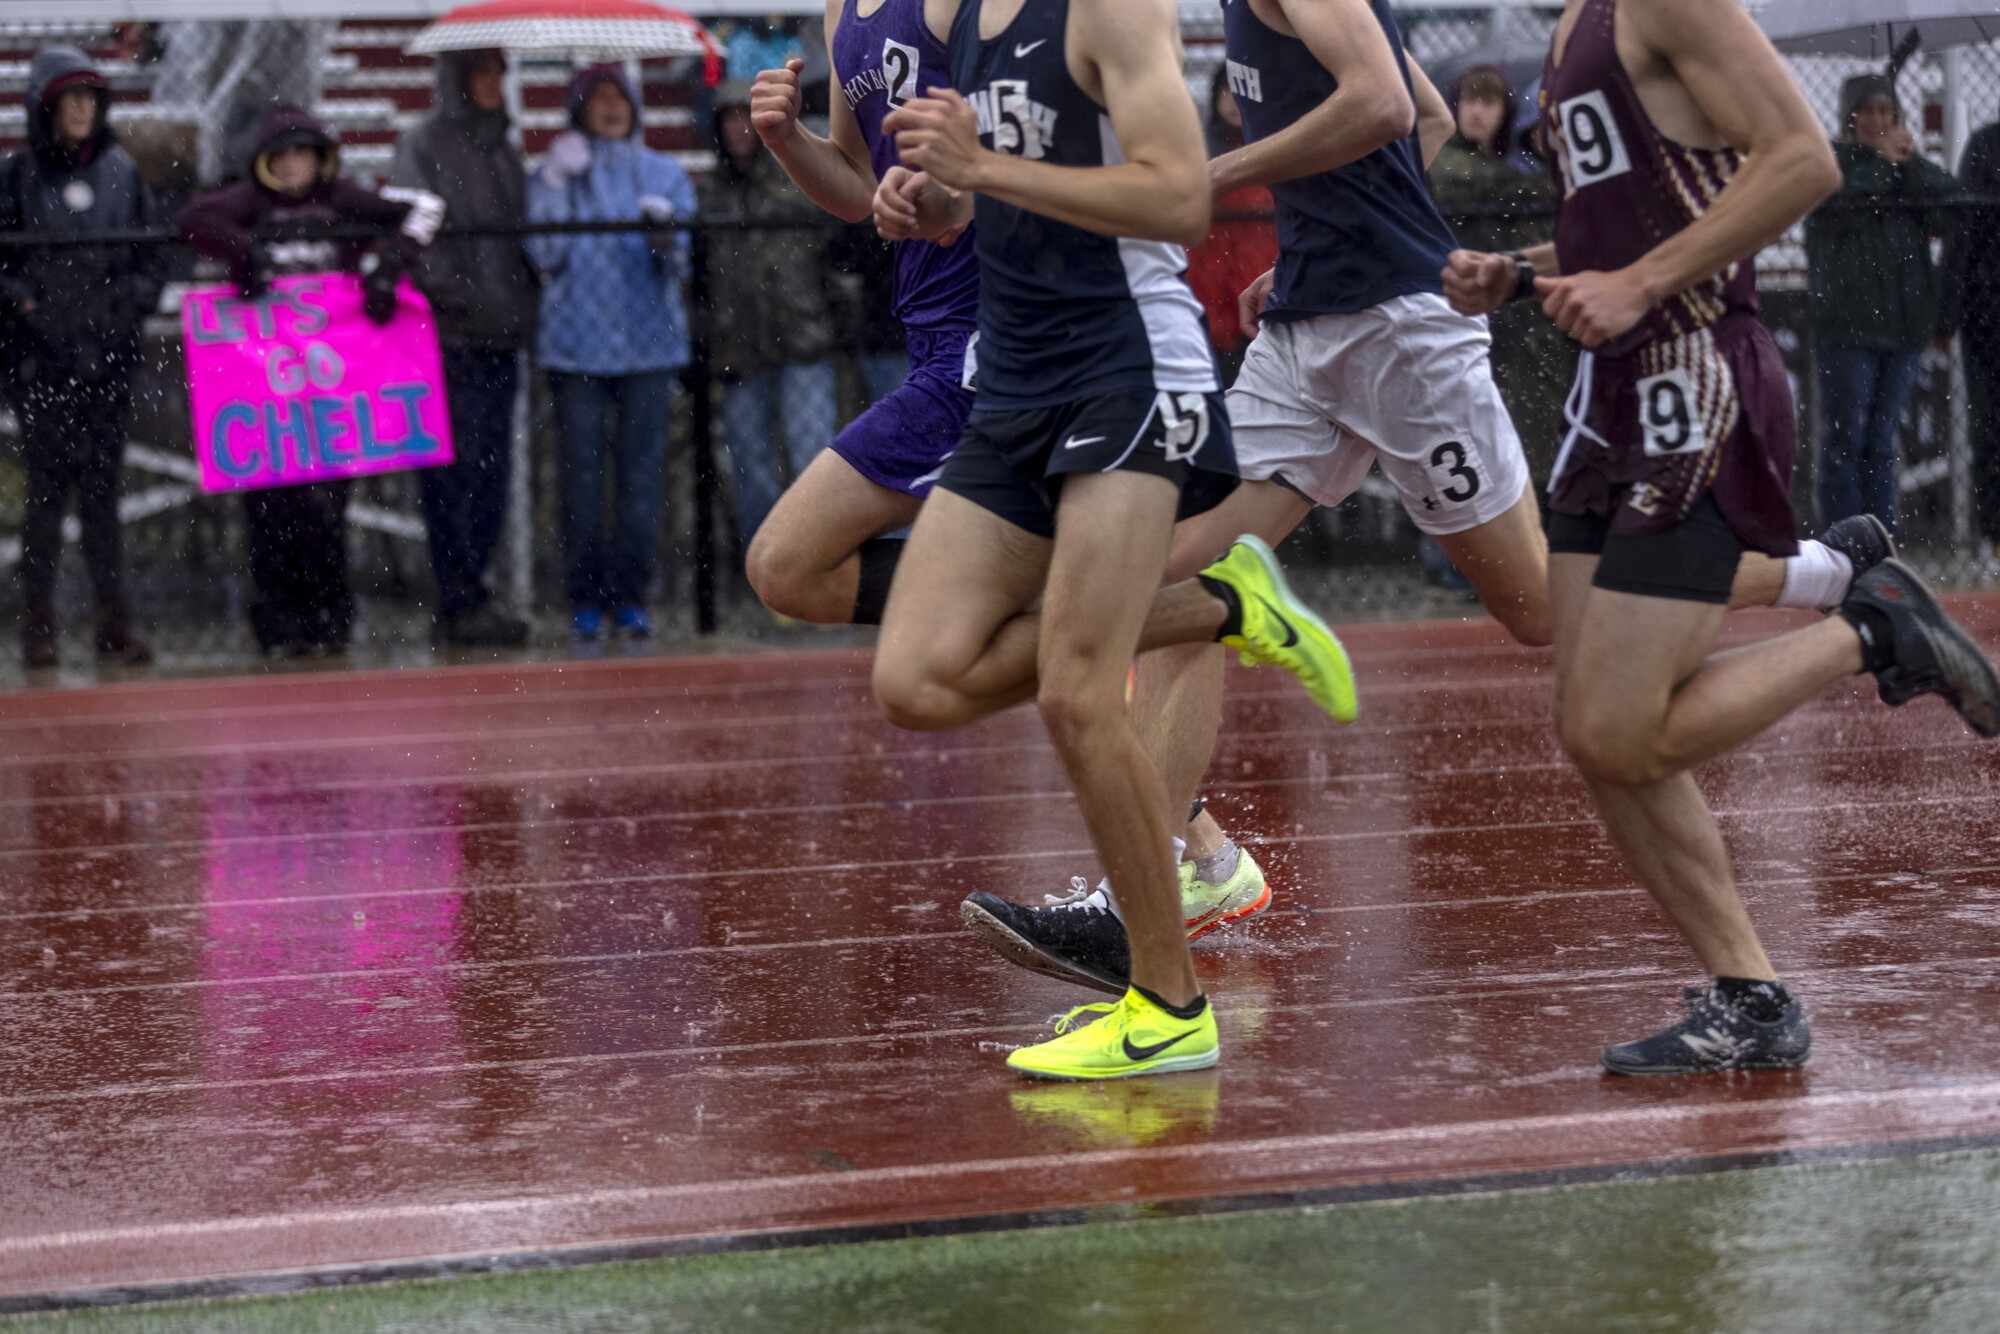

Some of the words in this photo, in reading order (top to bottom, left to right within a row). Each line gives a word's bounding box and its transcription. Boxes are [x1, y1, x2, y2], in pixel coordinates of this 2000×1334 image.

[885, 46, 910, 108] 2
[1226, 59, 1263, 103] TH
[996, 85, 1026, 156] 5
[1569, 103, 1613, 177] 9
[266, 344, 346, 395] GO
[211, 384, 439, 479] CHELI
[1168, 391, 1200, 454] 5
[1647, 379, 1691, 451] 9
[1430, 440, 1480, 502] 3
